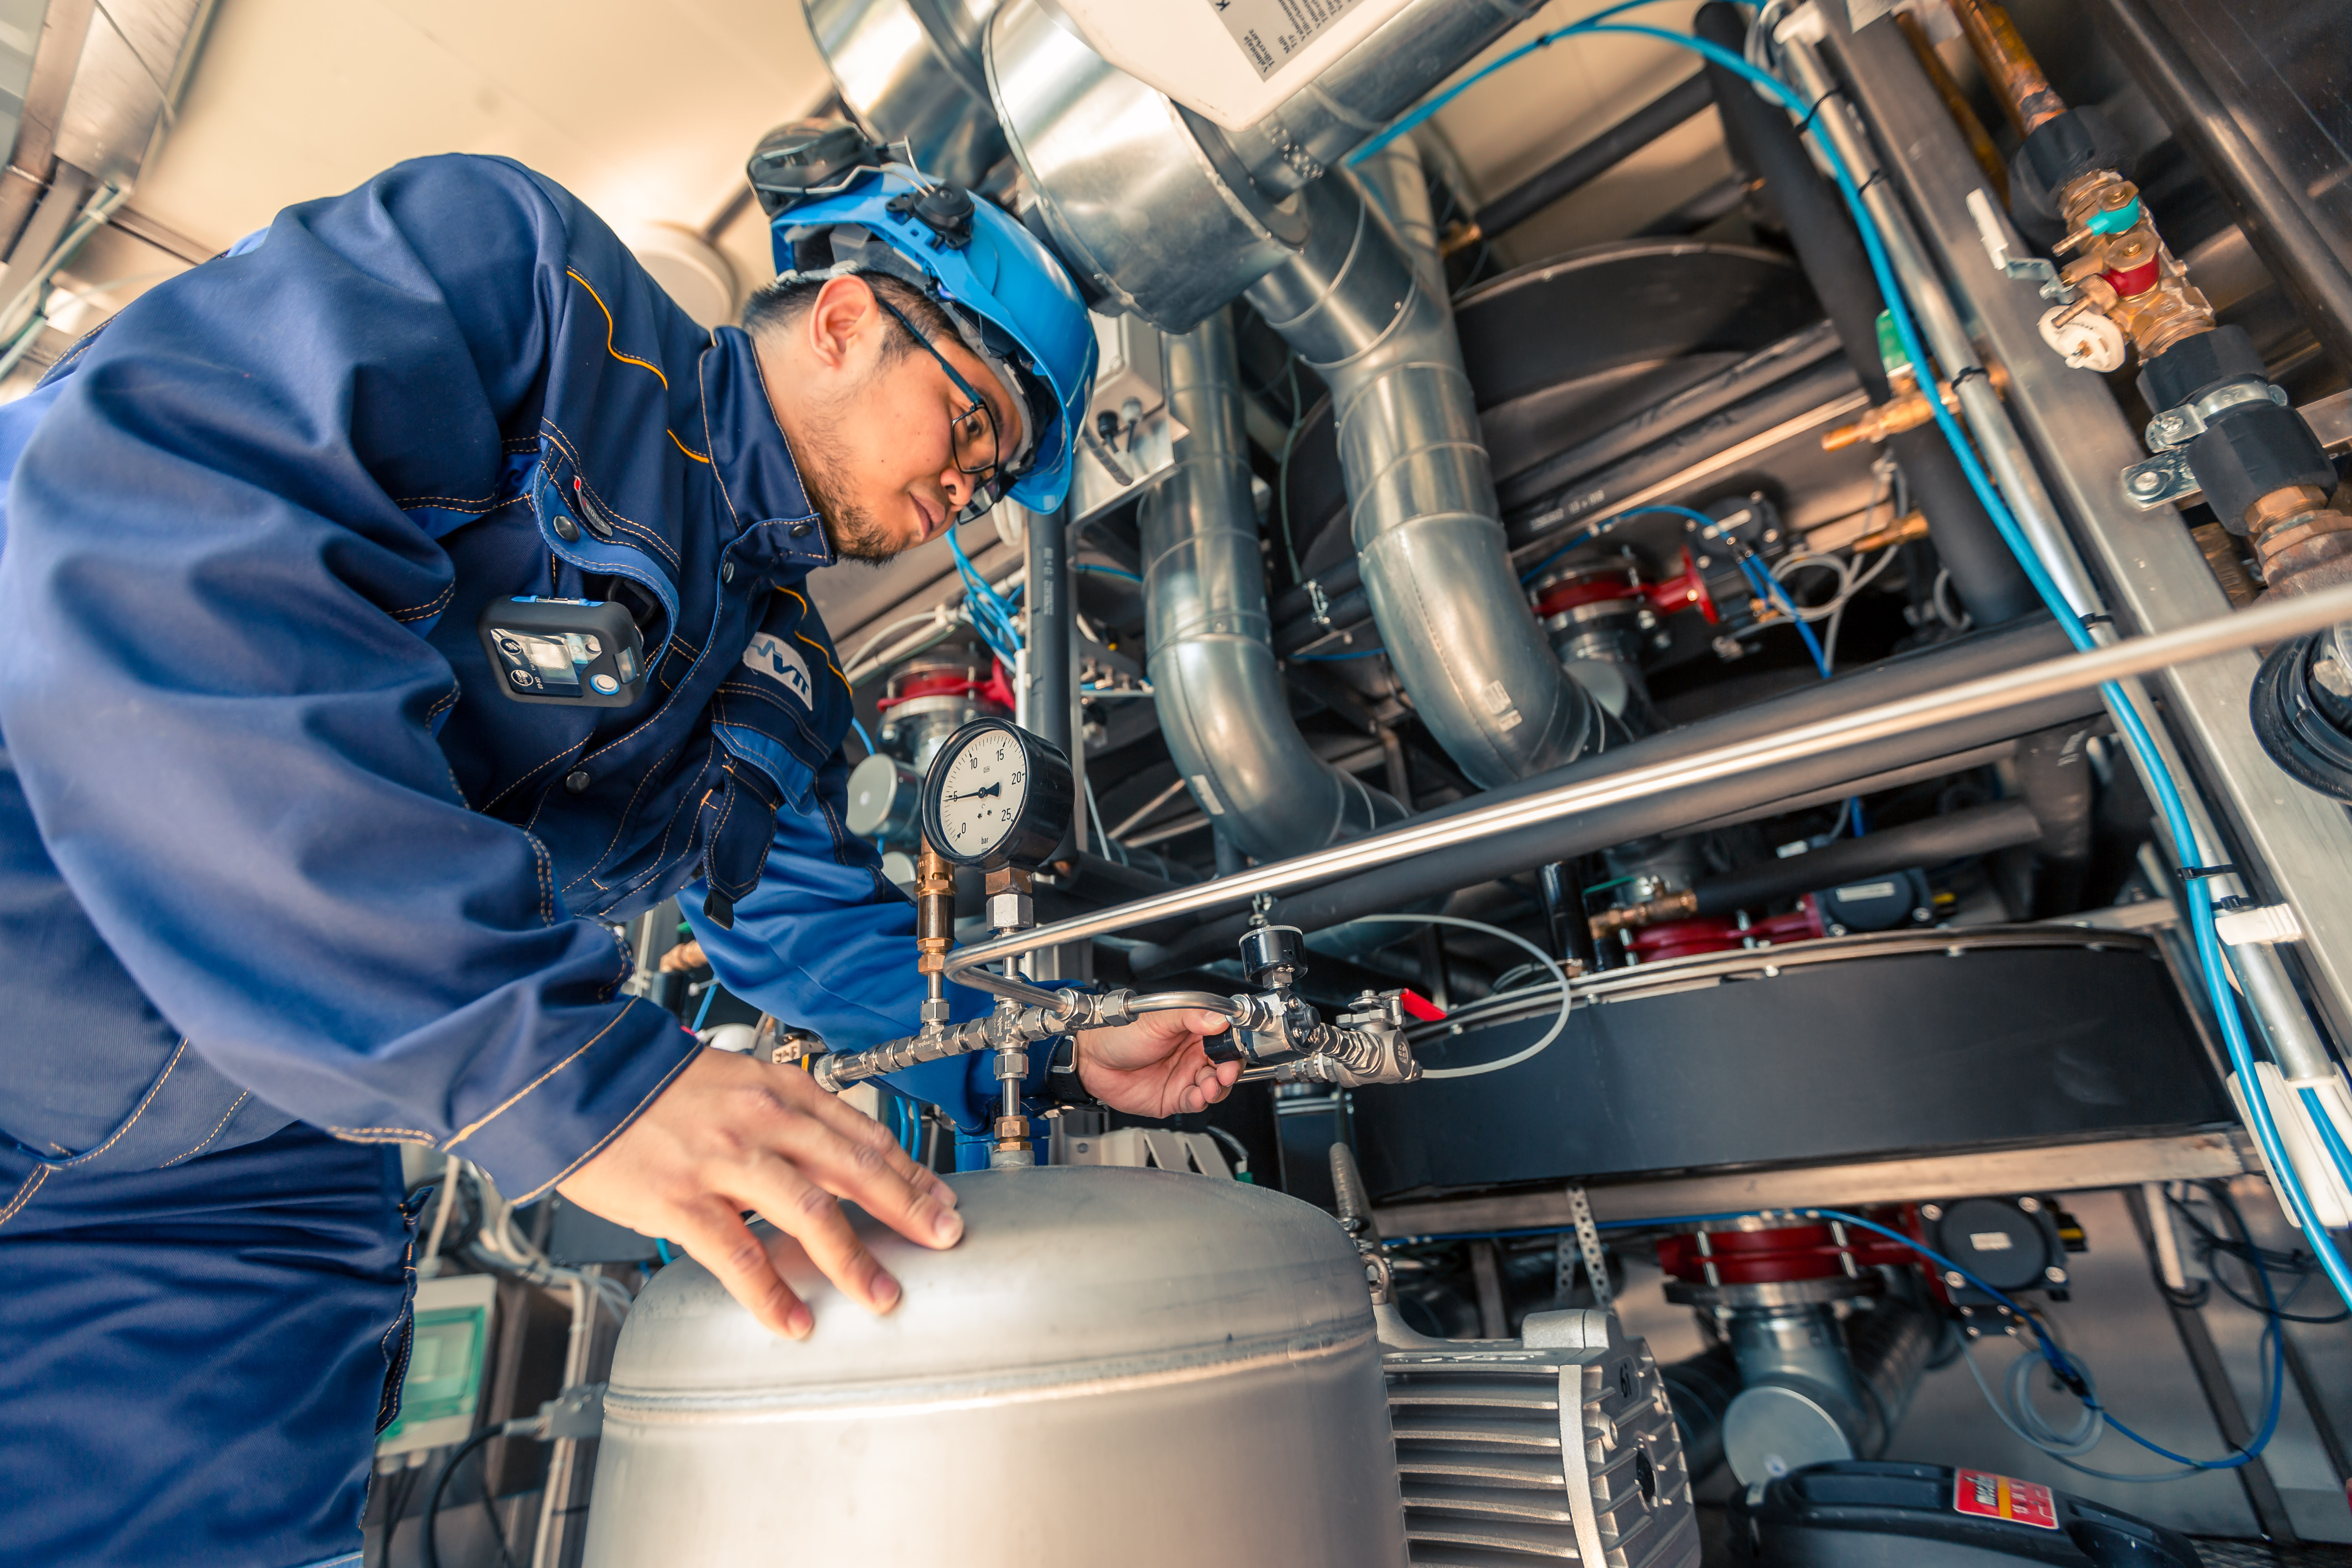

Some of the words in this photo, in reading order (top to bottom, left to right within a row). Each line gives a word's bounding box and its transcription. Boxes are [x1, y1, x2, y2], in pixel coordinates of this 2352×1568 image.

[1248, 28, 1275, 67] Tillverkare
[1278, 35, 1291, 54] Malli
[1288, 34, 1298, 49] Typ
[1243, 35, 1268, 73] Valmistaja
[773, 653, 809, 695] VTT
[996, 748, 1004, 762] 15
[969, 757, 978, 770] 10
[1011, 771, 1021, 785] 20
[953, 791, 958, 802] 5
[1001, 808, 1011, 822] 25
[962, 822, 966, 834] 0
[1620, 1362, 1632, 1398] 6i
